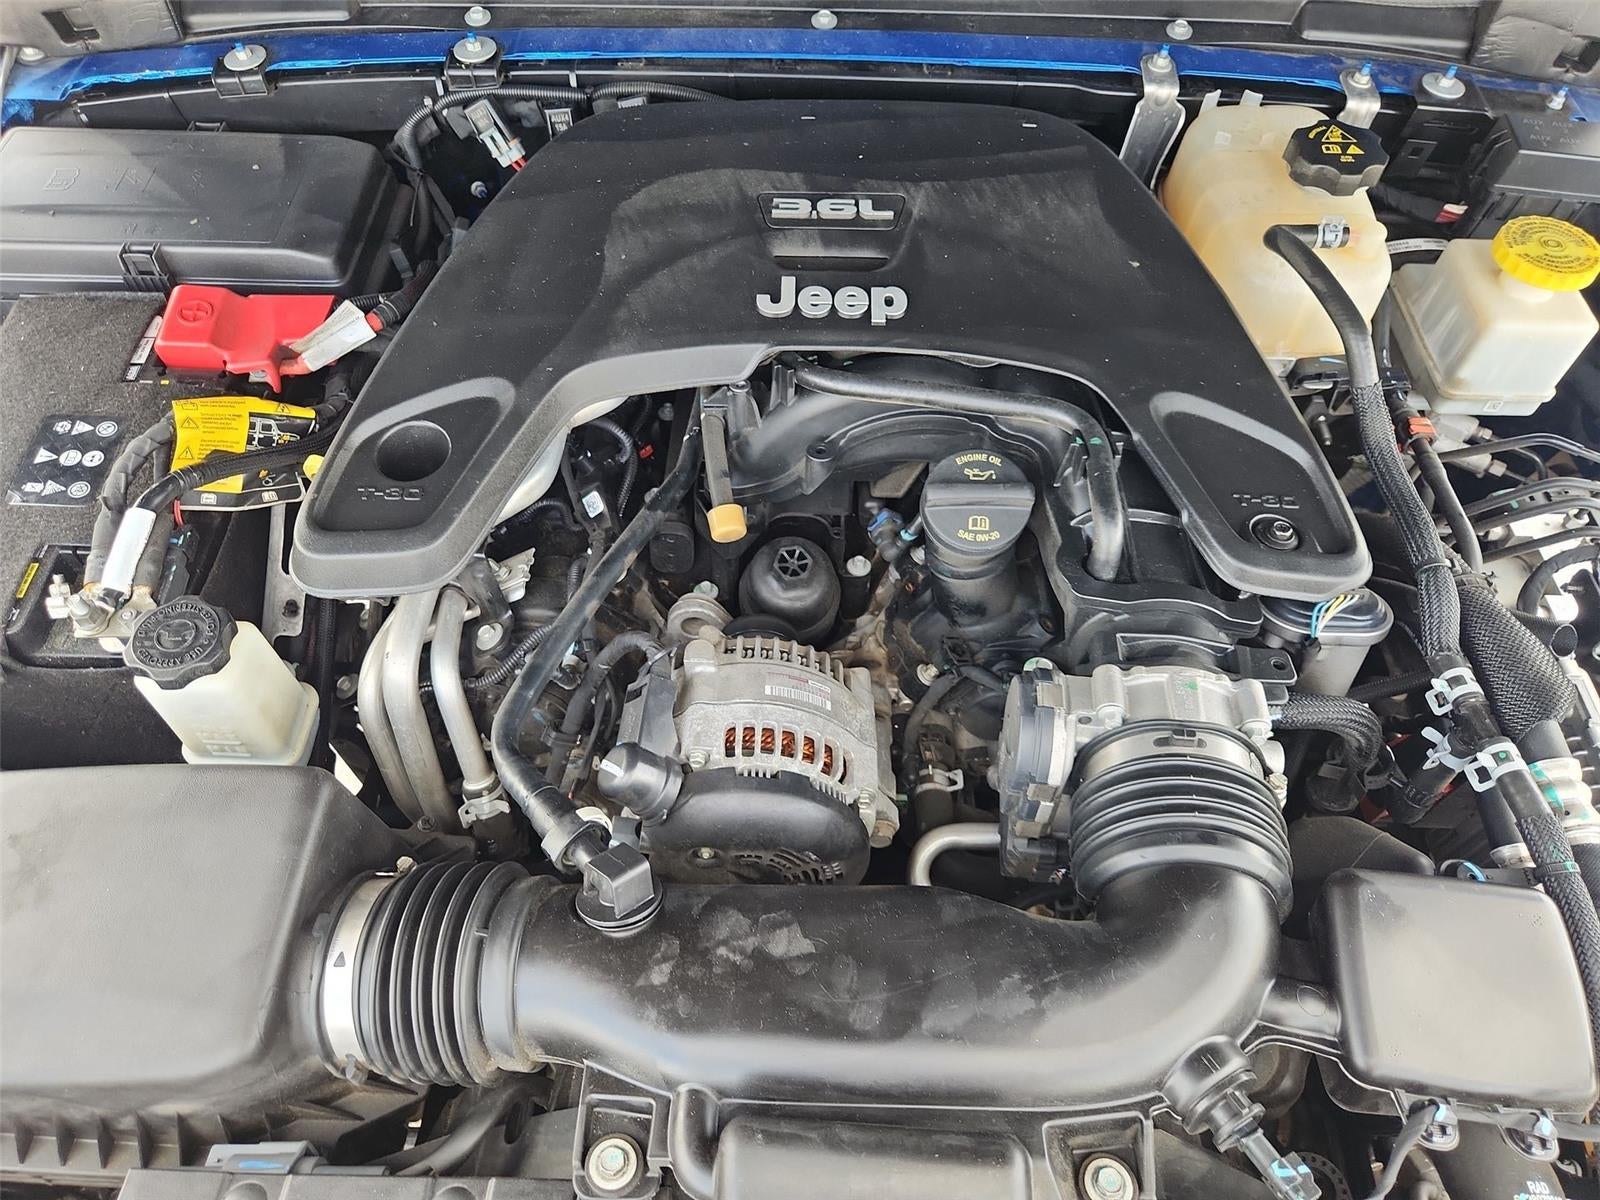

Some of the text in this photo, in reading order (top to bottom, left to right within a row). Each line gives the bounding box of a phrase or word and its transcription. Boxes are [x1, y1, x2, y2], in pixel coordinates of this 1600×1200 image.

[771, 197, 895, 221] 3.6L
[756, 275, 908, 326] Jeep
[955, 453, 1003, 467] ENGINE OIL
[357, 486, 423, 501] T-30
[957, 529, 1001, 542] SAE 0W-20
[157, 603, 200, 617] STEERING
[138, 648, 182, 666] APPROVED
[184, 646, 204, 661] USE
[1526, 1180, 1550, 1194] RAD
